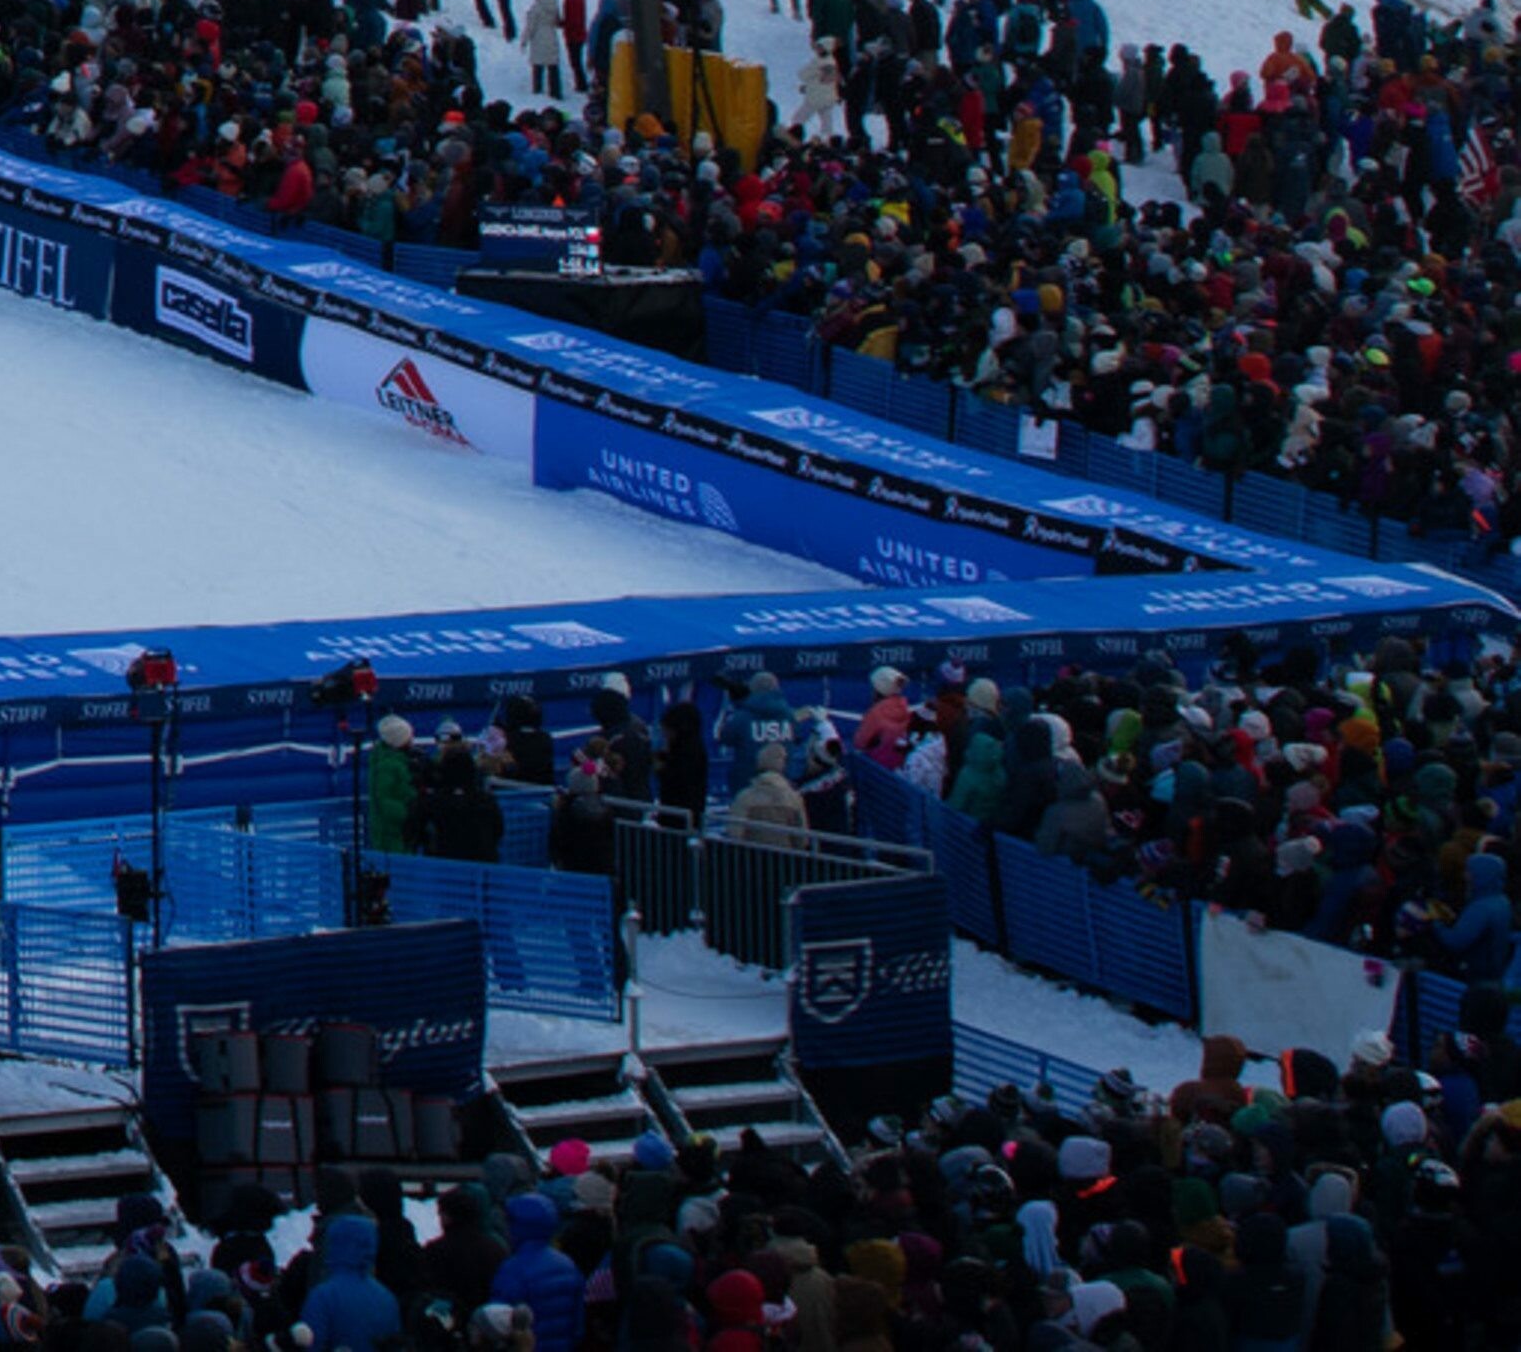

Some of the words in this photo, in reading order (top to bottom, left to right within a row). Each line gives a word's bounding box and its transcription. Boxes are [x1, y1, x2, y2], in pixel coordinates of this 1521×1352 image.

[376, 386, 455, 428] LEITNER
[601, 447, 693, 494] UNITED
[876, 536, 979, 582] UNITED
[741, 602, 920, 624] UNITED
[318, 628, 505, 648] UNITED
[750, 719, 795, 743] USA
